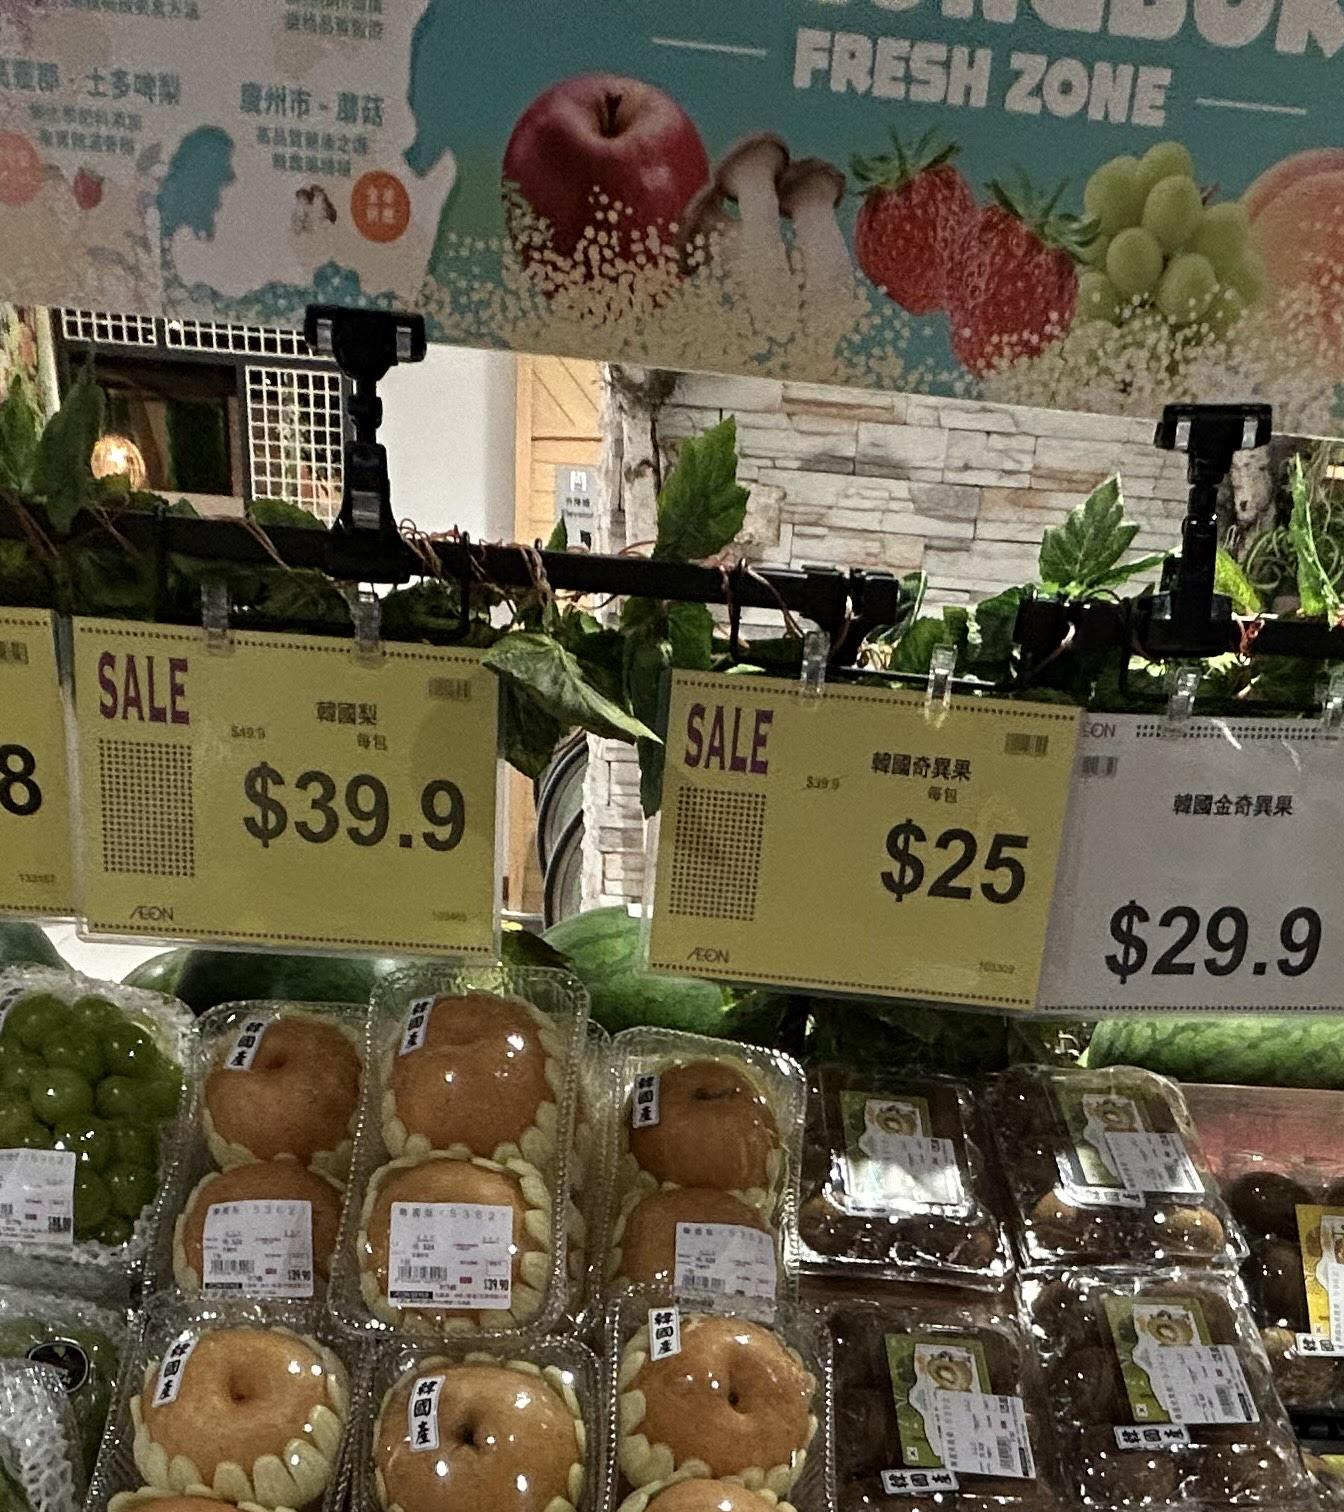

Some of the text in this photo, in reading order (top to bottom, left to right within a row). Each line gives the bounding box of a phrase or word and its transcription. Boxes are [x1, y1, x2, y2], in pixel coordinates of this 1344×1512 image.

[793, 27, 991, 108] FRESH
[1004, 52, 1172, 127] ZONE
[97, 650, 191, 726] SALE
[316, 700, 378, 727] 韓國梨
[683, 702, 775, 776] SALE
[871, 751, 973, 783] 韓國奇異果
[242, 760, 467, 853] $39.9
[1172, 793, 1295, 818] 韓國金奇異果
[879, 817, 1030, 905] $25
[1104, 899, 1323, 986] $29.9
[413, 1379, 440, 1447] 韓國產
